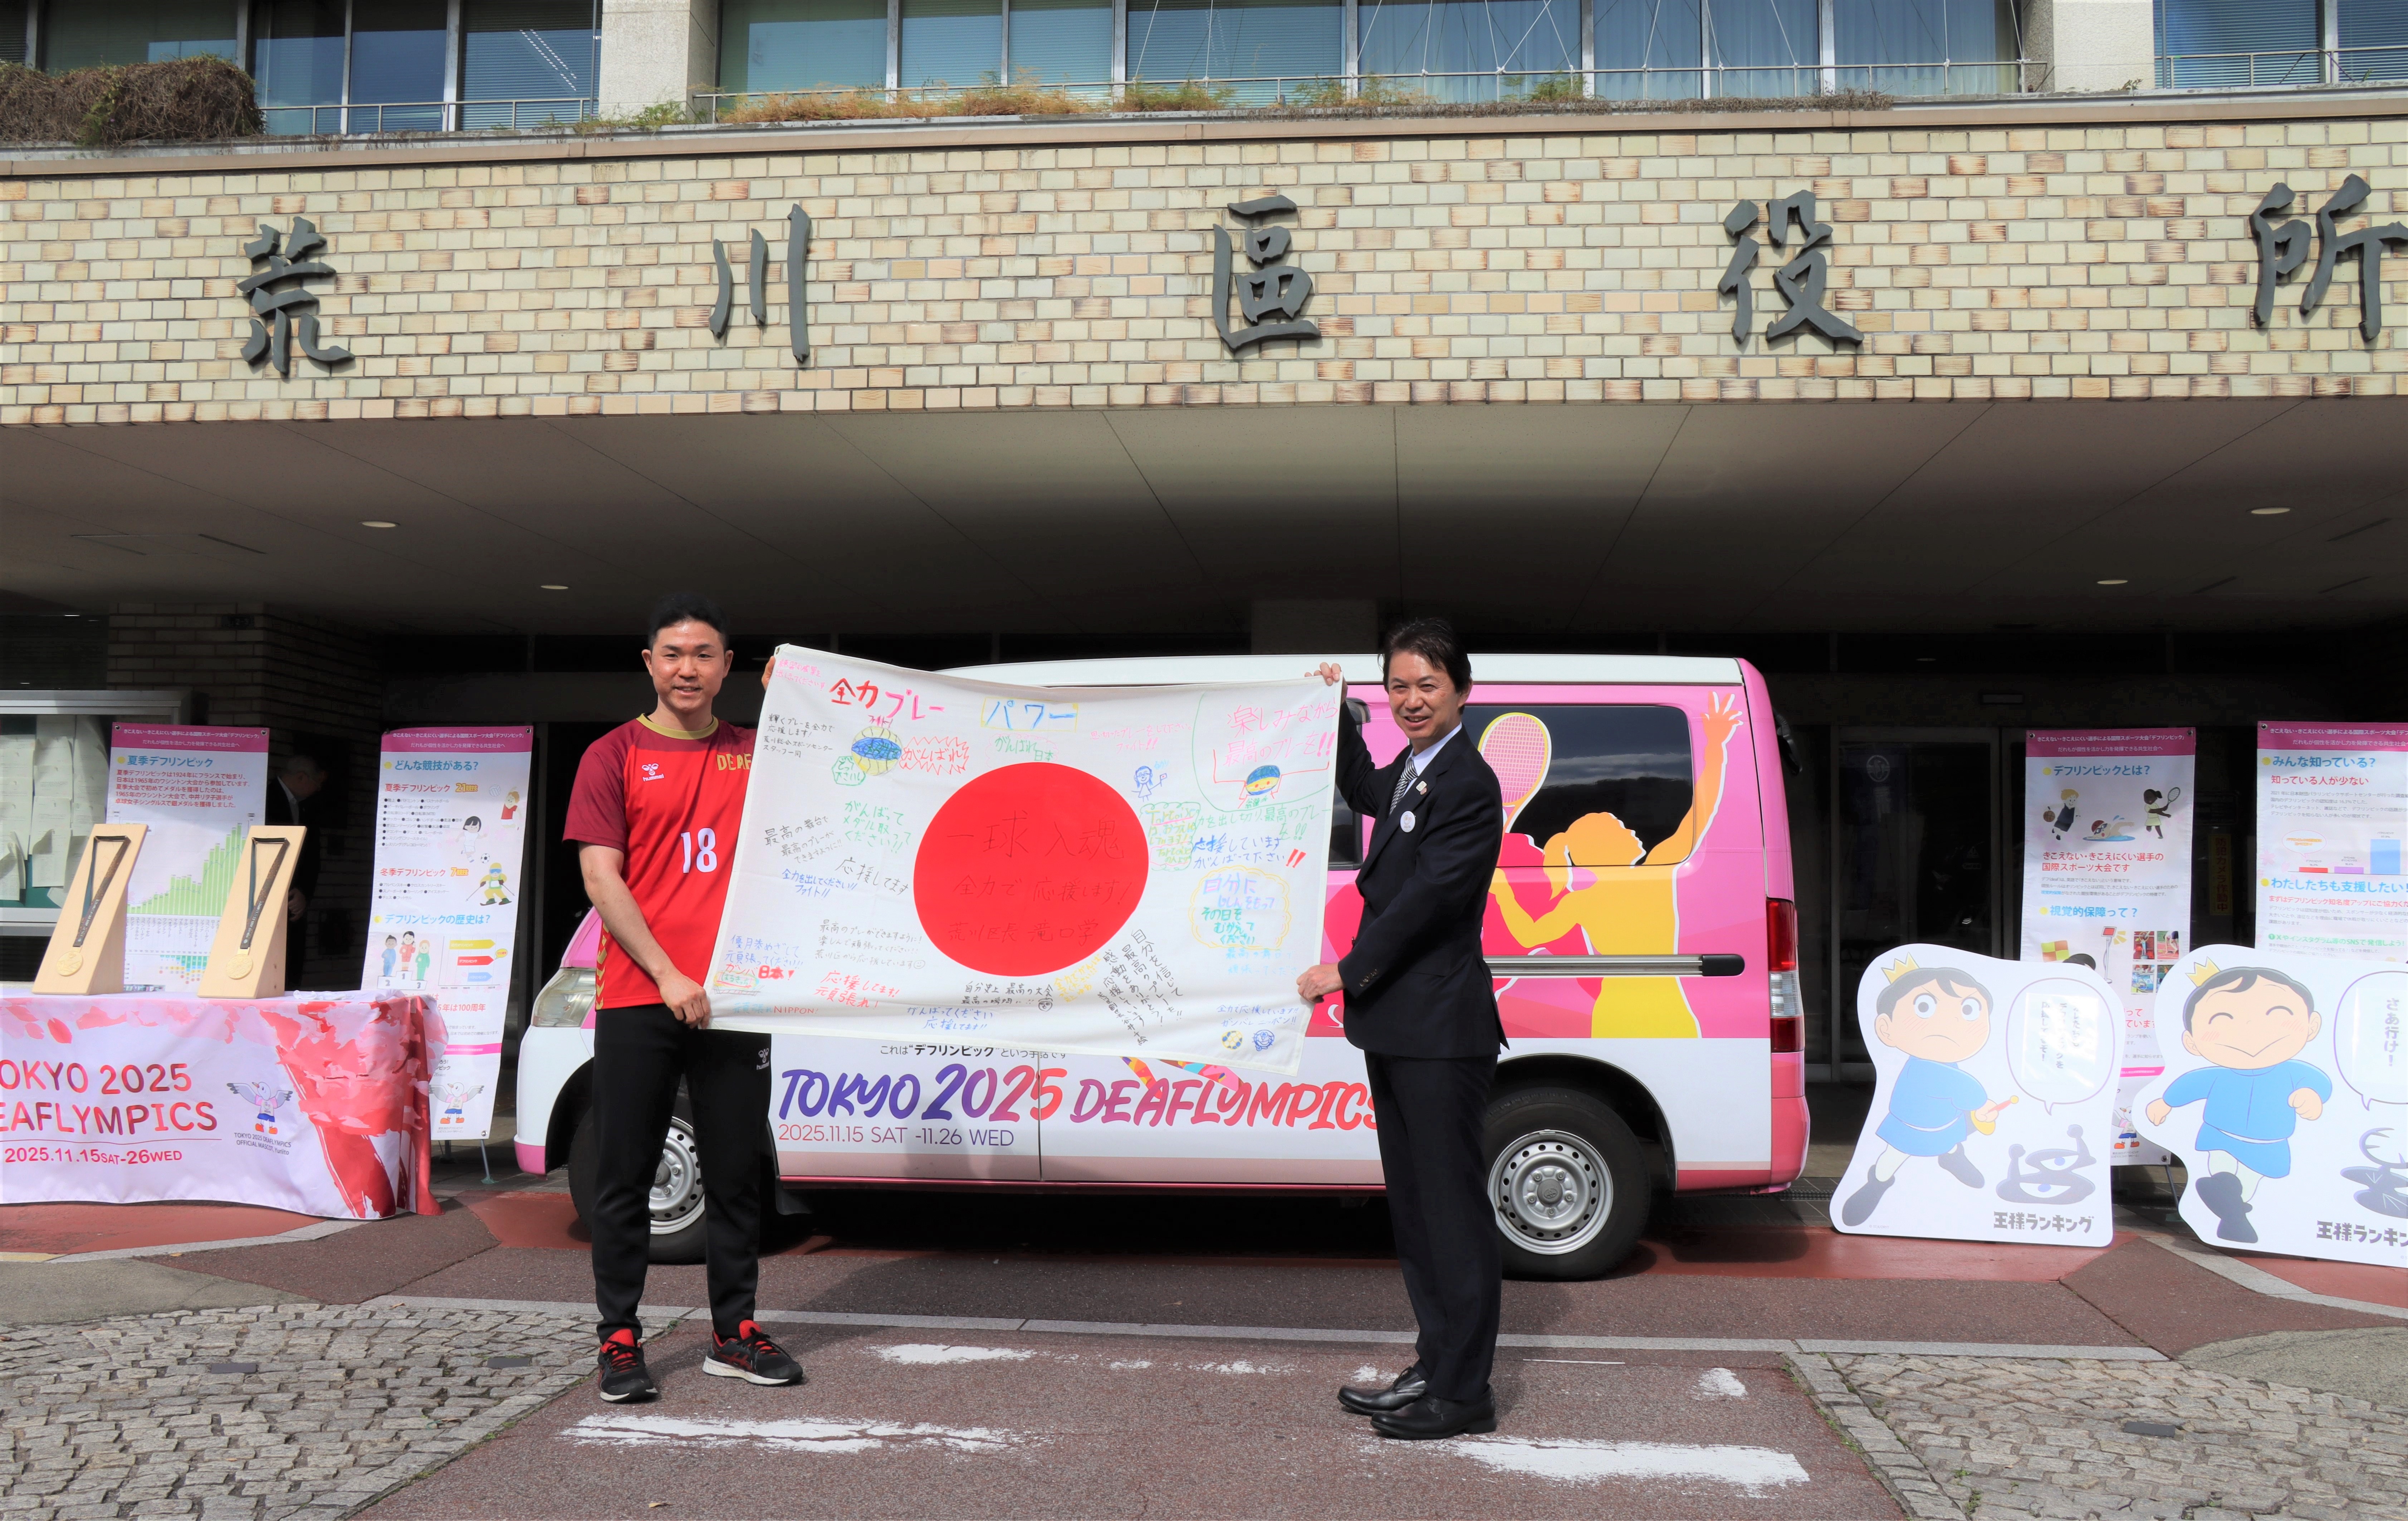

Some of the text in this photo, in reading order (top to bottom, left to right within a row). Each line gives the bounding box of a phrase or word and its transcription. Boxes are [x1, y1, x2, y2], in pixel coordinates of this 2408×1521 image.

[829, 678, 945, 721] 全力プレー
[984, 700, 1077, 730] パワー
[1227, 698, 1338, 737] 楽しみながら
[767, 725, 813, 738] 応援します!
[994, 735, 1037, 753] がんばれ
[127, 755, 213, 767] 夏季デフリンピック
[1034, 749, 1054, 762] 日本
[2272, 756, 2376, 768] みんな知っている?
[395, 760, 479, 771] どんな競技がある?
[2054, 765, 2150, 776] デフリンピックとは?
[642, 773, 664, 781] hummel
[2271, 775, 2369, 786] 知っている人が少ない
[385, 783, 450, 793] 夏季デフリンピック
[844, 800, 905, 827] がんばって
[947, 810, 1128, 861] 一球入魂
[781, 830, 835, 857] 最高のプレーが
[681, 827, 717, 874] 18
[2042, 852, 2164, 861] きこえない・きこえにくい選手の
[380, 868, 446, 877] 冬季デフリンピック
[2042, 863, 2130, 873] 国際スポーツ大会です
[835, 857, 909, 896] 応援してます
[2050, 905, 2138, 918] 視覚的保障って?
[385, 914, 490, 926] デフリンピックの歴史は?
[2384, 998, 2400, 1067] さあ行け!
[100, 1063, 192, 1095] 2025
[778, 1068, 922, 1120] TOKYO
[920, 1063, 1068, 1121] 2025
[779, 1123, 864, 1143] 2025.11.15
[871, 1126, 907, 1144] SAT
[970, 1130, 1014, 1147] WED
[263, 1136, 292, 1148] DEAFLYMPICS
[1993, 1211, 2095, 1234] 王様ランキング
